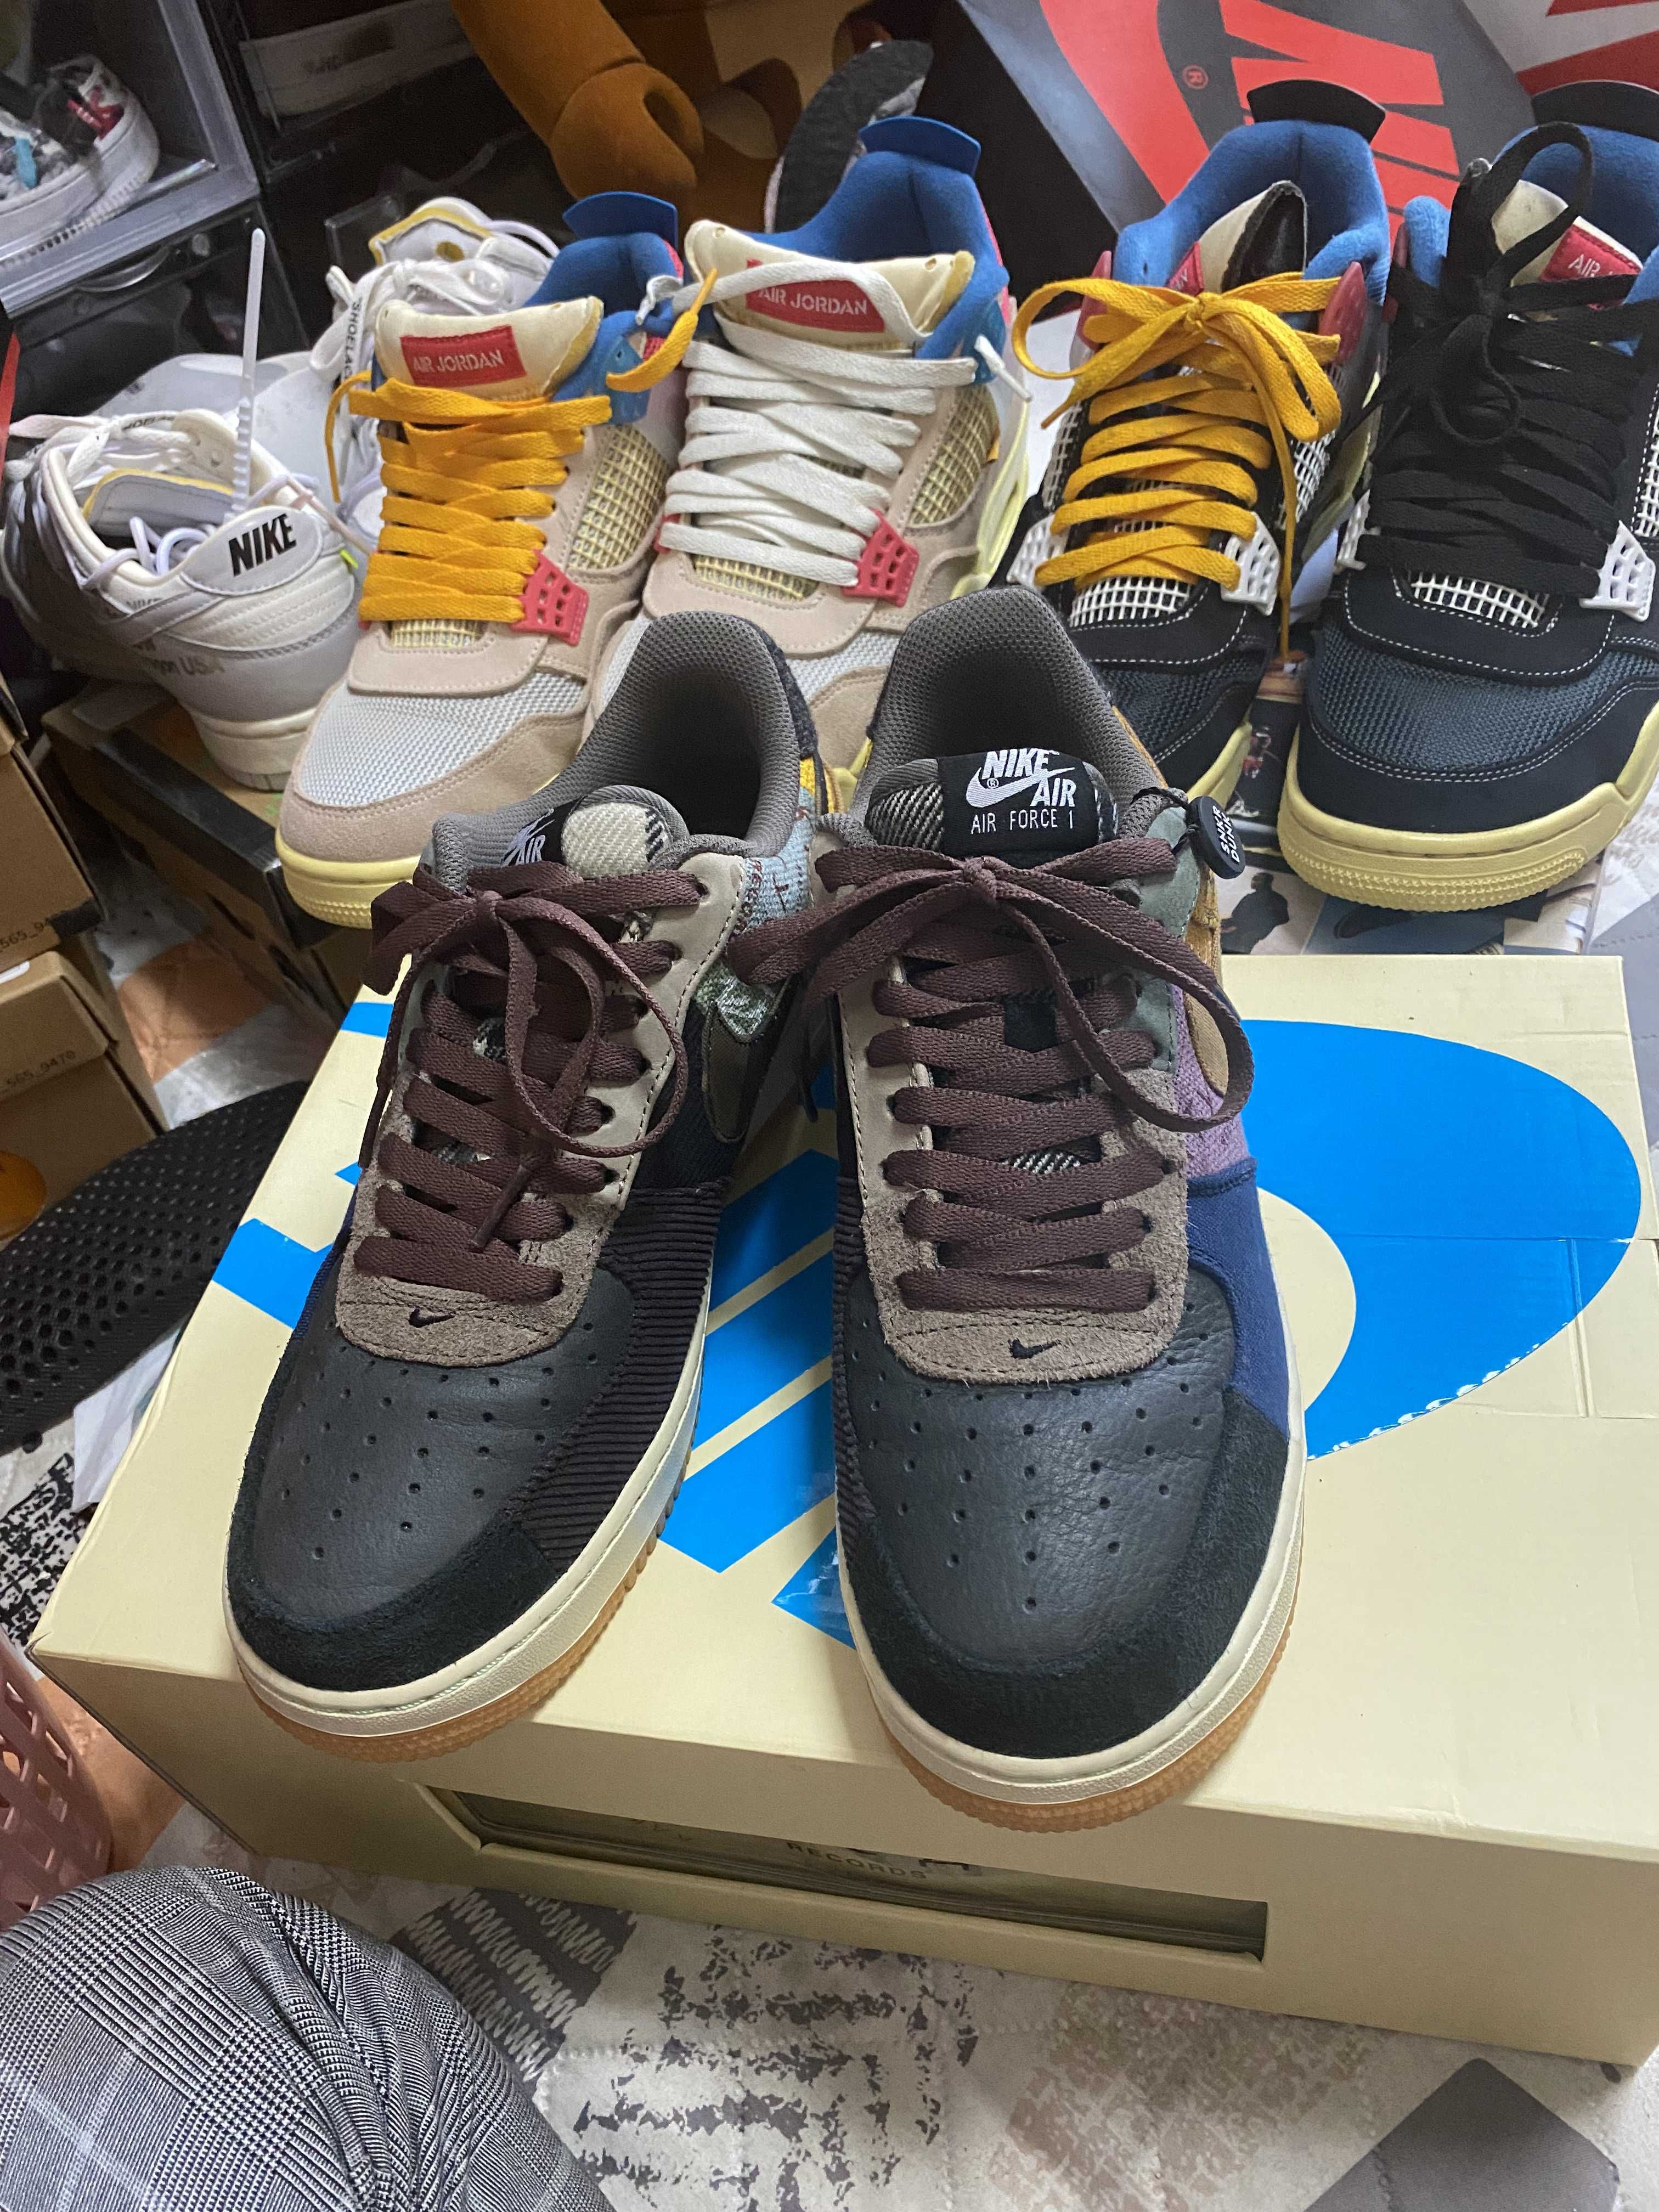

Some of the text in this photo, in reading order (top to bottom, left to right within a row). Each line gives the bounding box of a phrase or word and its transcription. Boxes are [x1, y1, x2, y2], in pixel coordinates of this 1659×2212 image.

[1568, 254, 1601, 278] AIR
[759, 287, 868, 315] AIR JORDAN
[413, 349, 505, 374] AIR JORDAN
[228, 512, 297, 578] NIKE
[981, 747, 1060, 780] NIKE
[1029, 777, 1077, 807] AIR
[970, 811, 997, 835] AIR
[1009, 808, 1058, 831] FORCE
[1212, 805, 1230, 855] SNKR
[1221, 811, 1240, 863] DUNK
[786, 1842, 927, 1880] RECORDS
